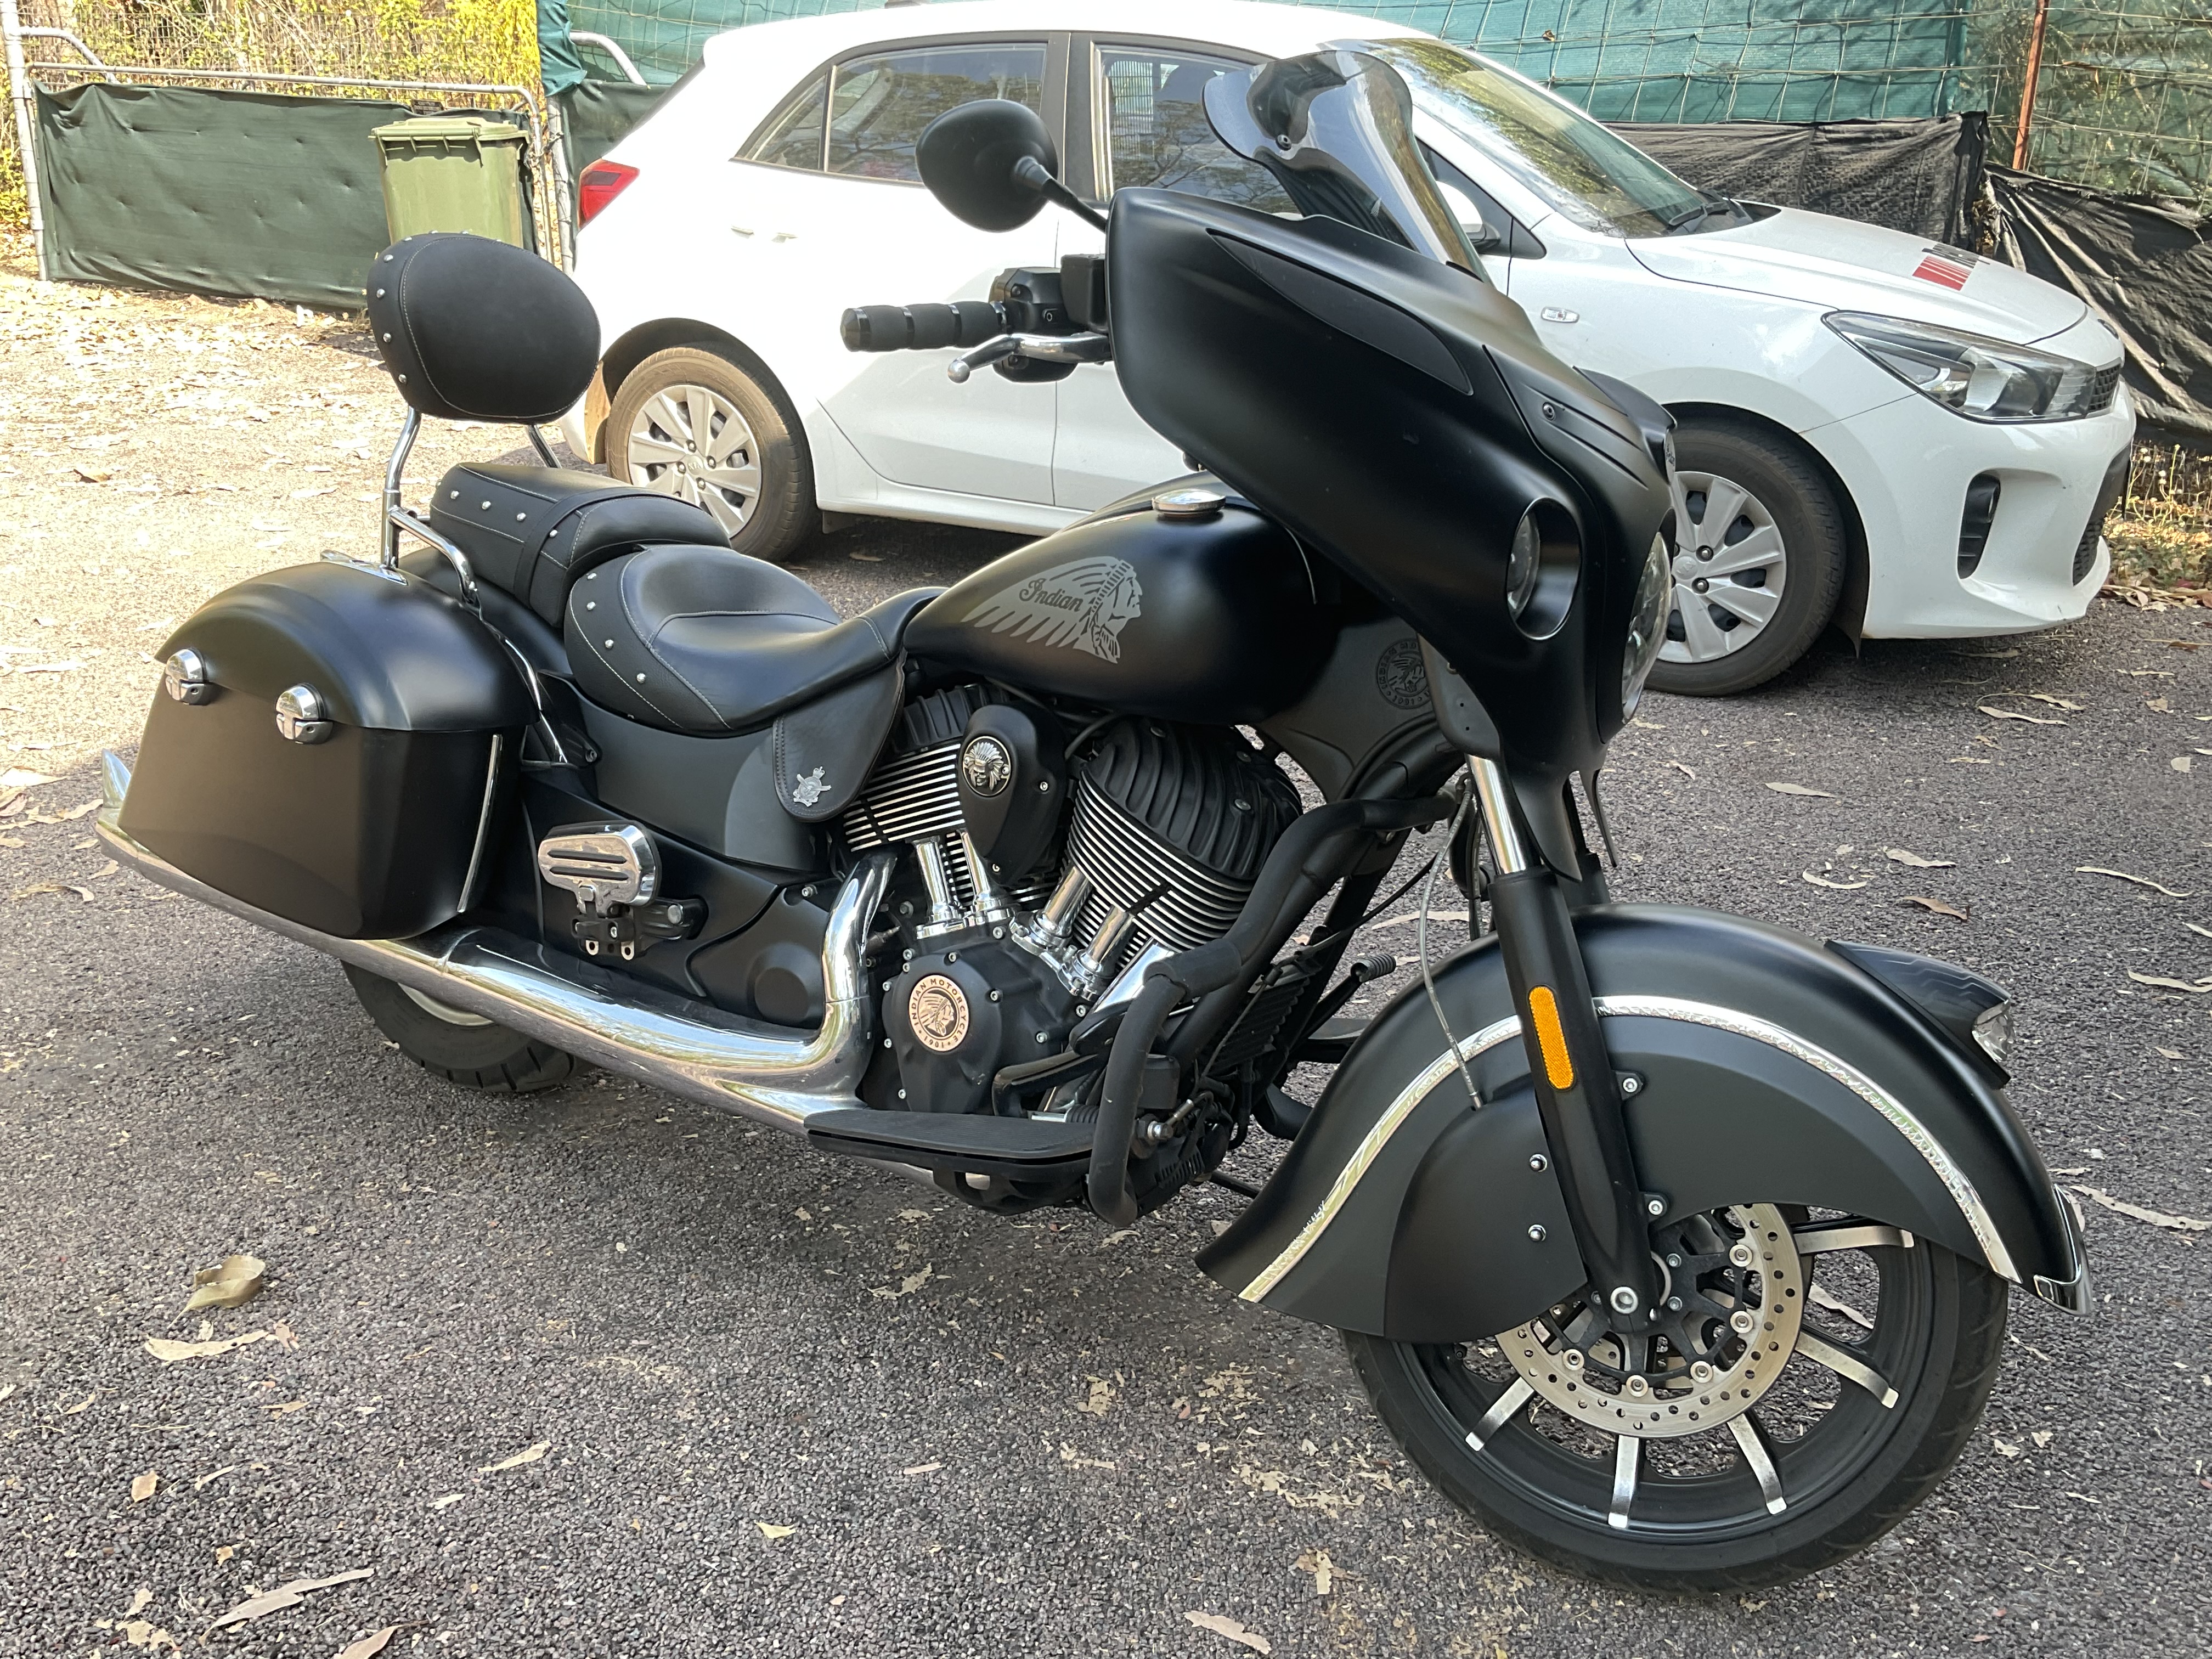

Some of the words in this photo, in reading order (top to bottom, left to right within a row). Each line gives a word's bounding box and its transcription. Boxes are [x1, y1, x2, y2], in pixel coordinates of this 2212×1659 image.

[1019, 578, 1084, 612] Indian
[911, 982, 926, 1026] INDIAN
[930, 978, 967, 1042] MOTORCYCLE
[924, 1036, 944, 1048] 1901
